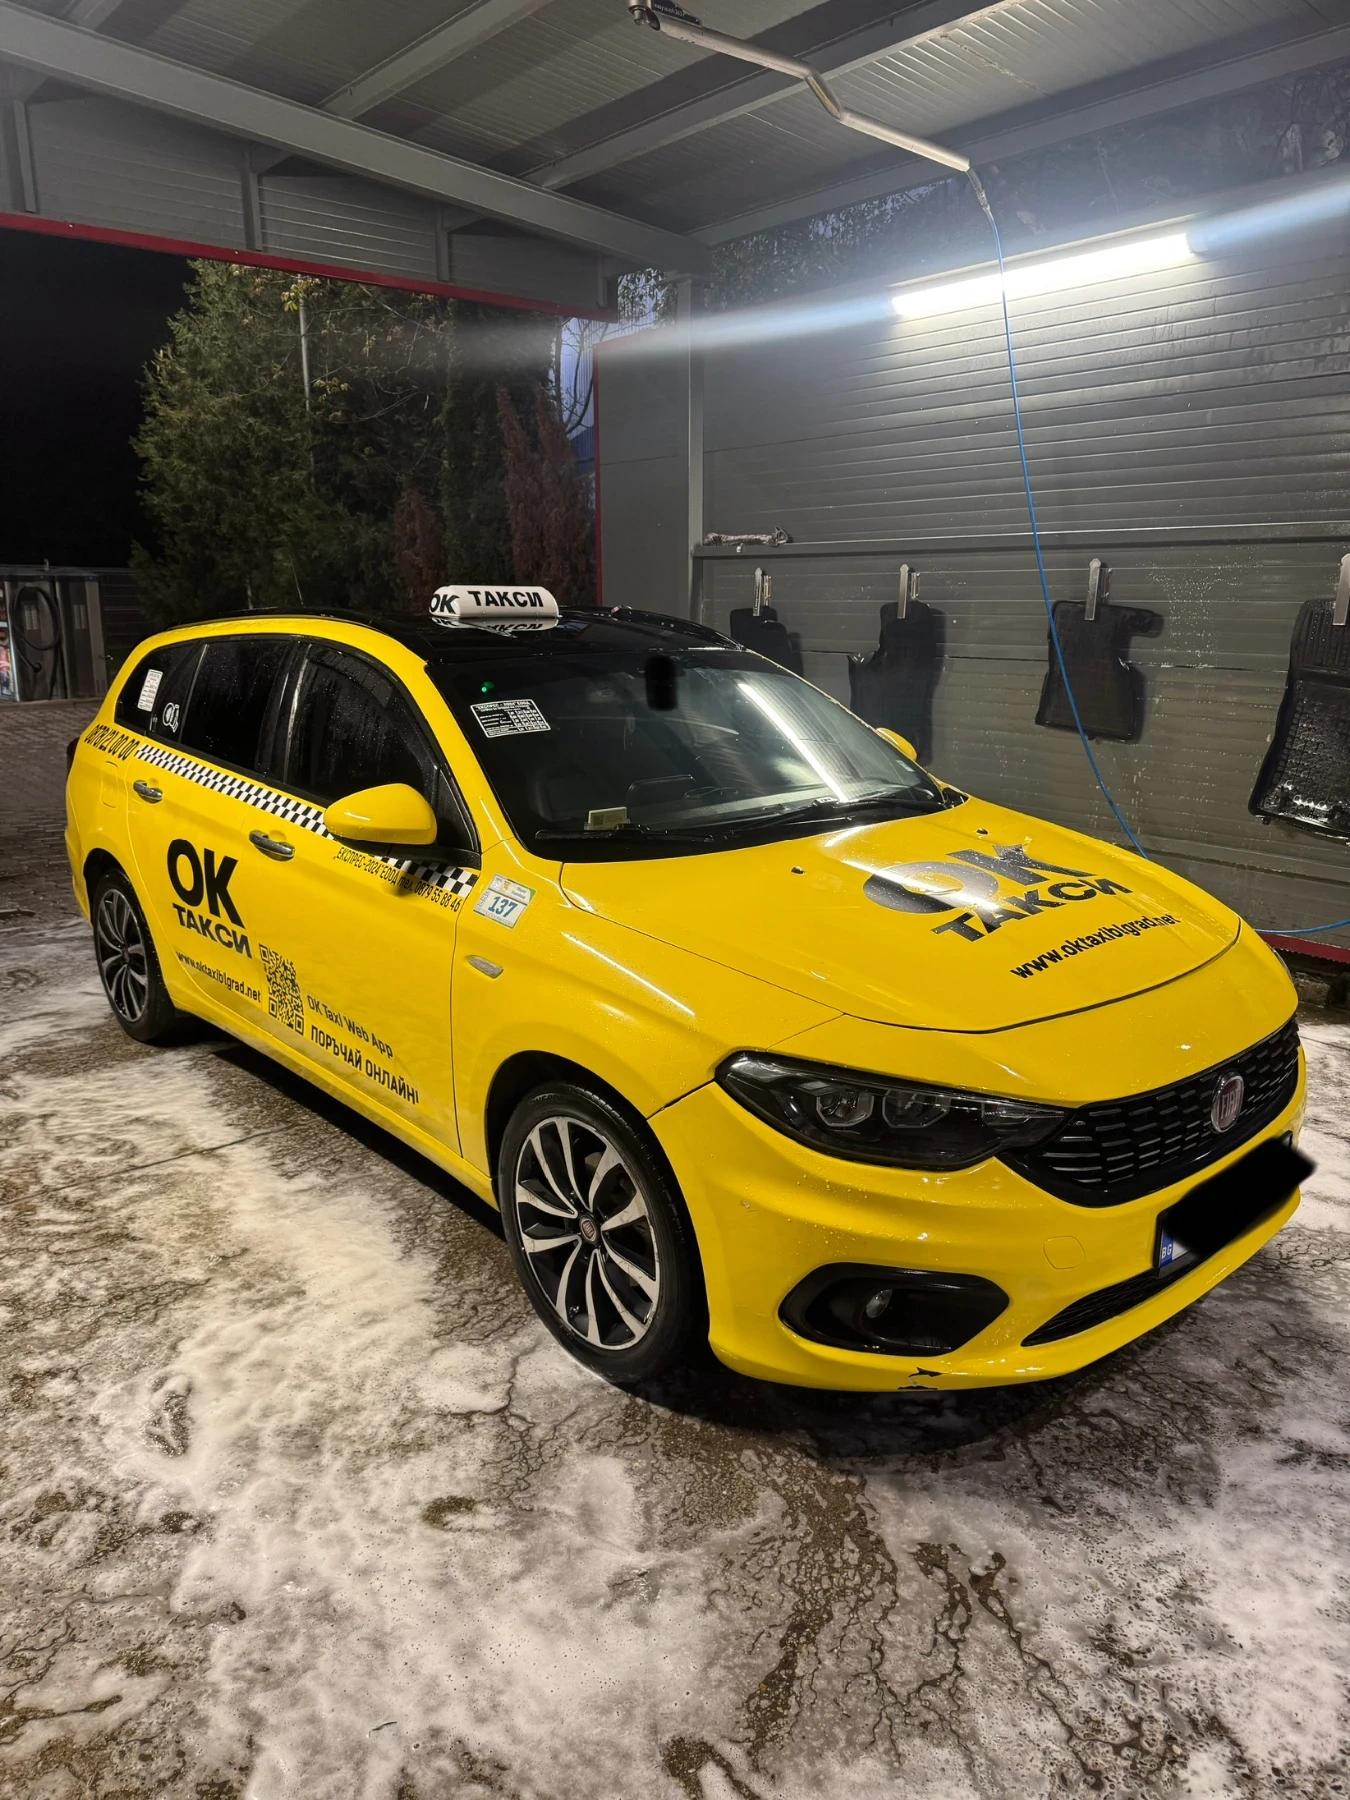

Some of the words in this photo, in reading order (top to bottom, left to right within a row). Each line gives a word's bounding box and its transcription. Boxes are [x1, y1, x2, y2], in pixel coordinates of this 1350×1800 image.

[467, 591, 544, 607] ТАКСИ
[108, 733, 129, 755] 00
[118, 738, 140, 760] 00
[413, 881, 433, 899] 0879
[430, 885, 443, 903] 55
[440, 891, 453, 908] 88
[449, 898, 462, 913] 46
[488, 896, 518, 918] 137
[931, 878, 1133, 942] ТАКСИ
[172, 902, 252, 959] ТАКСИ
[1010, 914, 1181, 979] www.oktaxiblgrad.net
[307, 995, 322, 1016] OK
[321, 1003, 344, 1028] Taxi
[343, 1016, 370, 1043] Web
[371, 1033, 393, 1059] App
[311, 1024, 362, 1071] ПОРЪЧАЙ
[1161, 1244, 1173, 1259] BG
